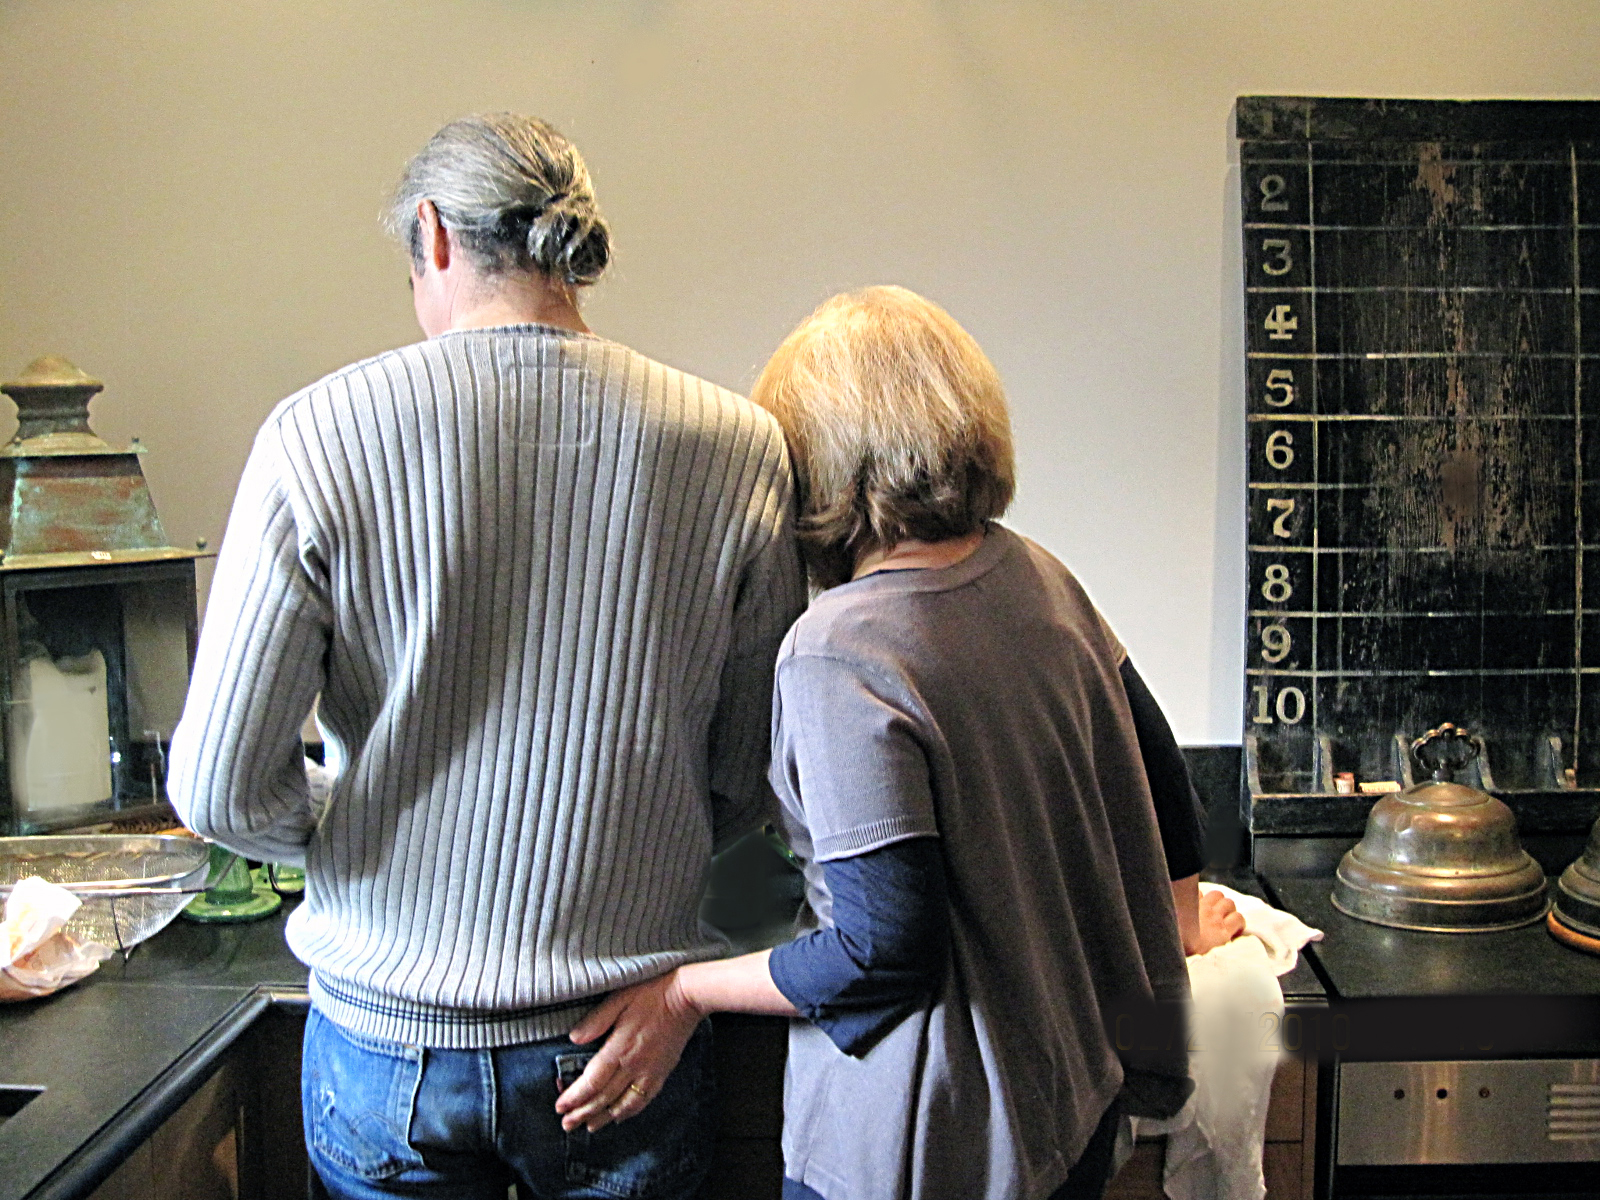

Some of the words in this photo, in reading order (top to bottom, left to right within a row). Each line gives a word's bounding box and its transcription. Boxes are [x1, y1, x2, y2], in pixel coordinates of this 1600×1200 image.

[1260, 174, 1289, 211] 2
[1262, 239, 1293, 276] 3
[1264, 305, 1298, 339] 4
[1264, 369, 1294, 407] 5
[1265, 430, 1294, 469] 6
[1267, 498, 1295, 538] 7
[1261, 564, 1293, 602] 8
[1261, 624, 1292, 663] 9
[1252, 685, 1306, 724] 10
